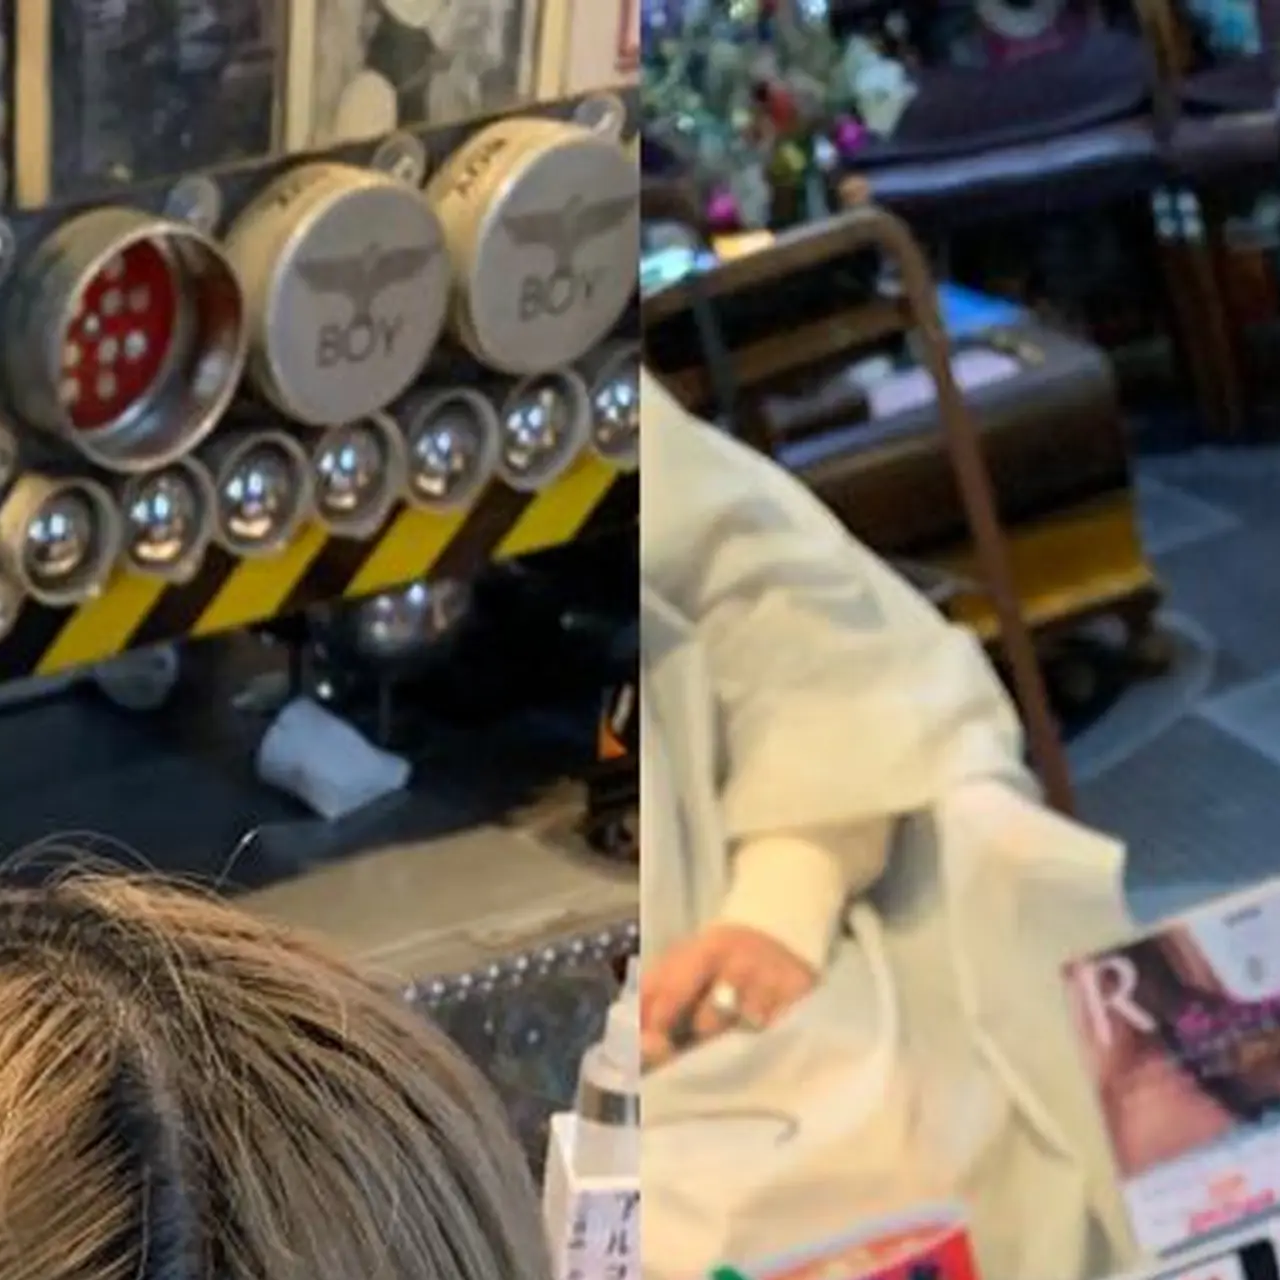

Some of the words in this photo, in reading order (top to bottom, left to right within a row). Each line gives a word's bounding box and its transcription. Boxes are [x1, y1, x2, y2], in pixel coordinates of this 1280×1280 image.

[520, 268, 601, 322] BOY
[316, 315, 404, 368] BOY
[1081, 956, 1157, 1046] R
